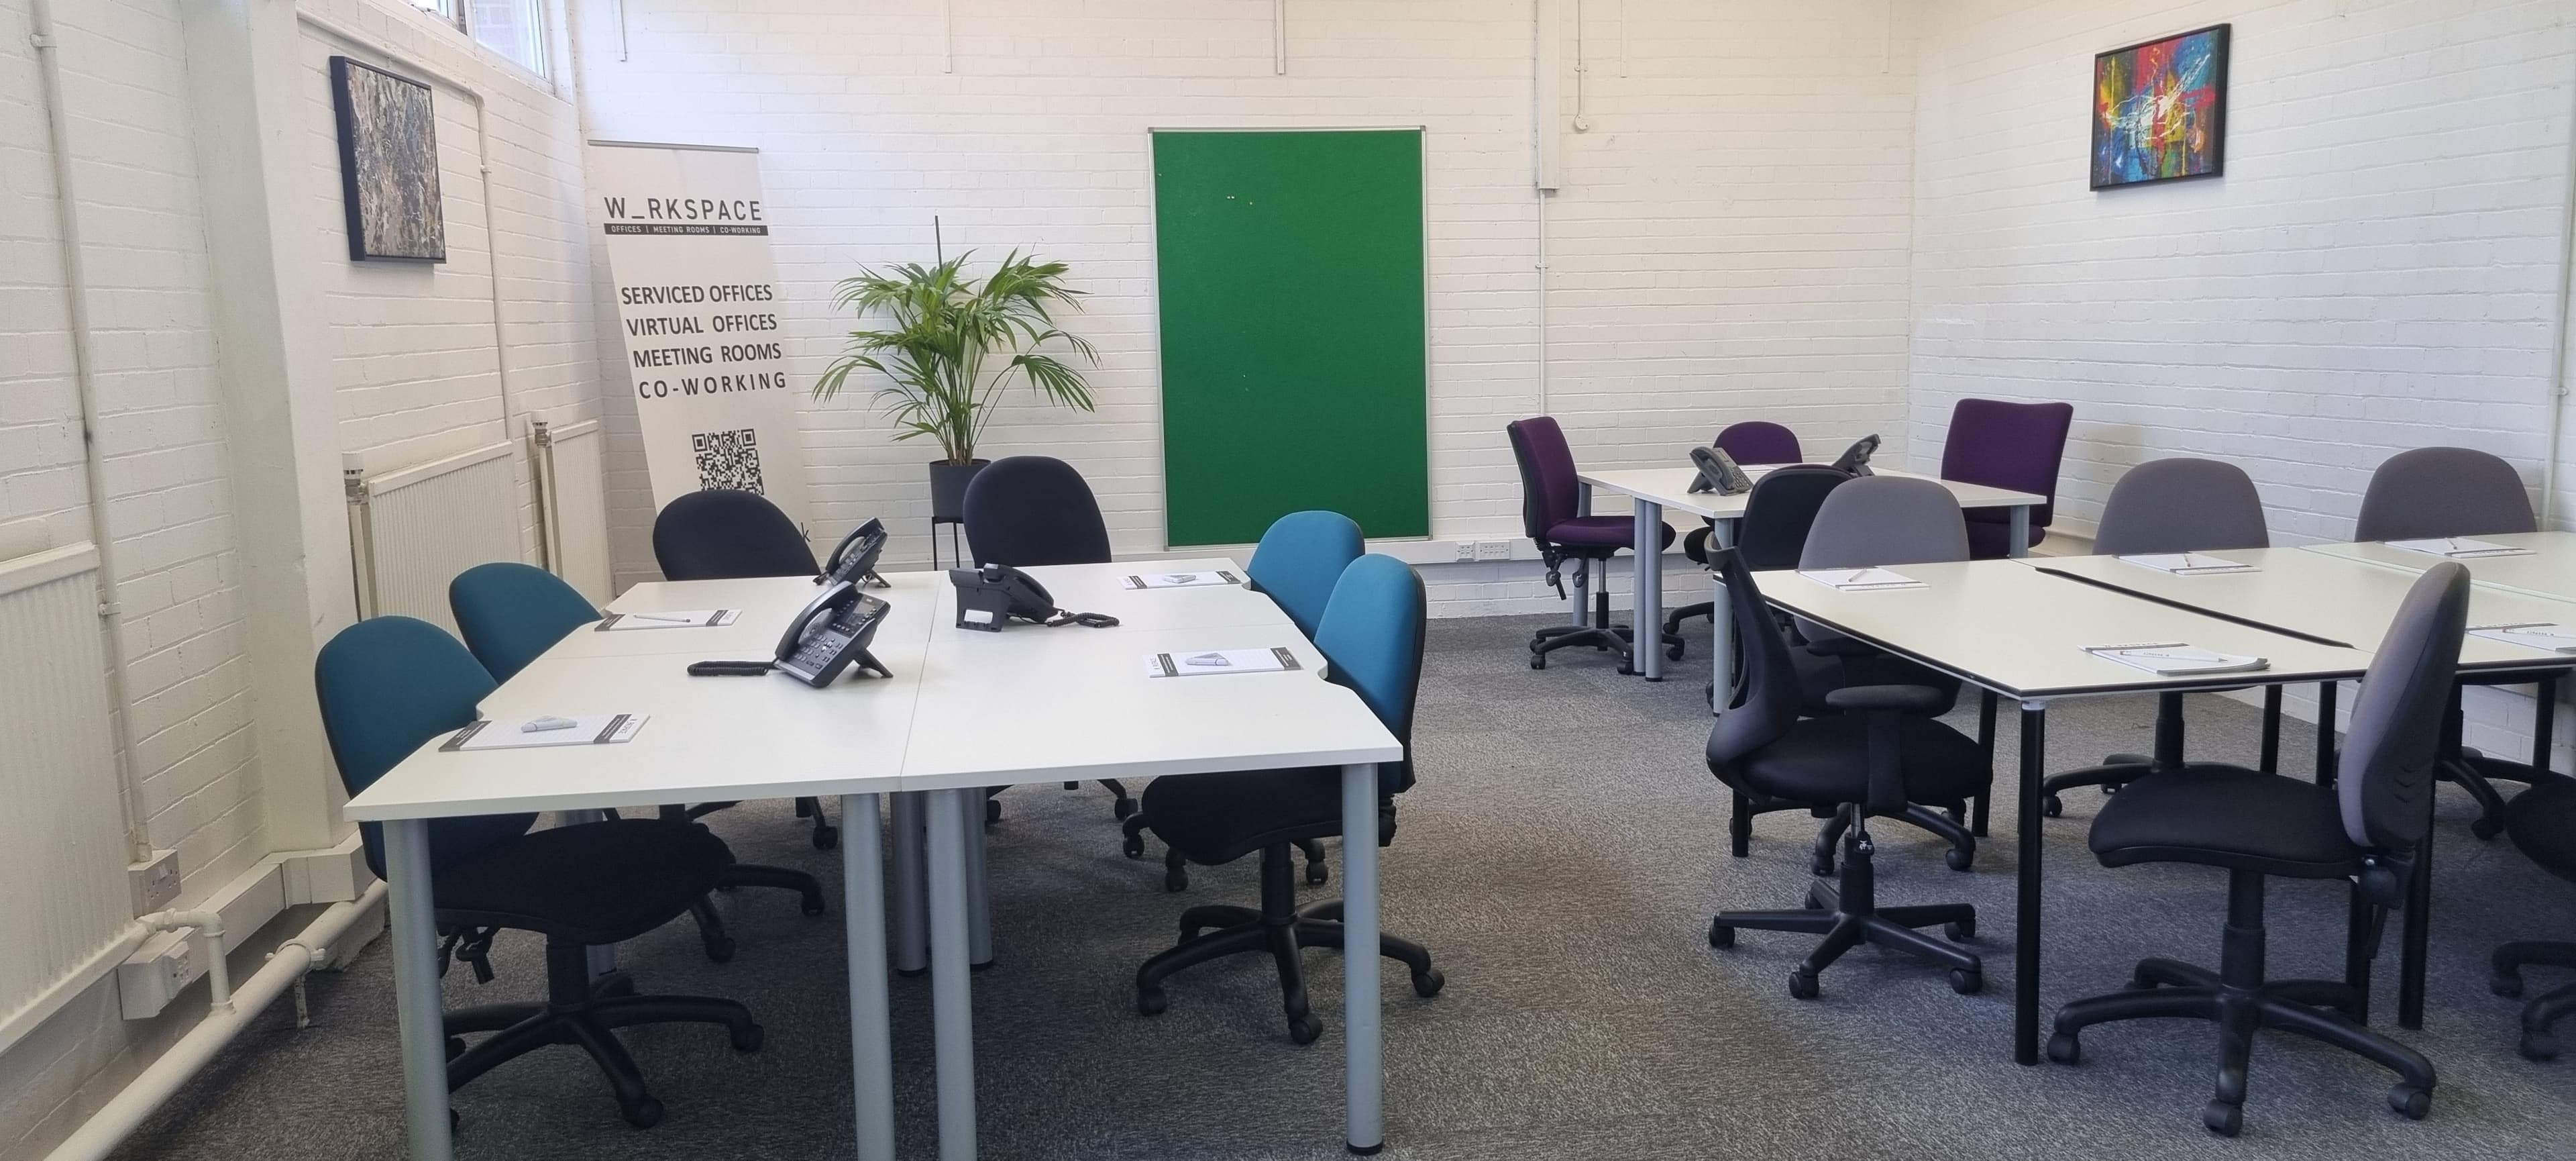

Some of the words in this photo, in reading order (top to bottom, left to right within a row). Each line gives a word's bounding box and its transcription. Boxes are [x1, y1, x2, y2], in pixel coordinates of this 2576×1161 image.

[604, 197, 762, 221] W_RKSPACE
[611, 225, 641, 233] OFFICES
[653, 225, 684, 234] MEETING
[621, 286, 705, 305] SERVICED
[709, 284, 773, 302] OFFICES
[627, 316, 704, 336] VIRTUAL
[712, 313, 777, 333] OFFICES
[633, 346, 712, 368] MEETING
[720, 343, 782, 363] ROOMS
[639, 372, 786, 399] CO-WORKING
